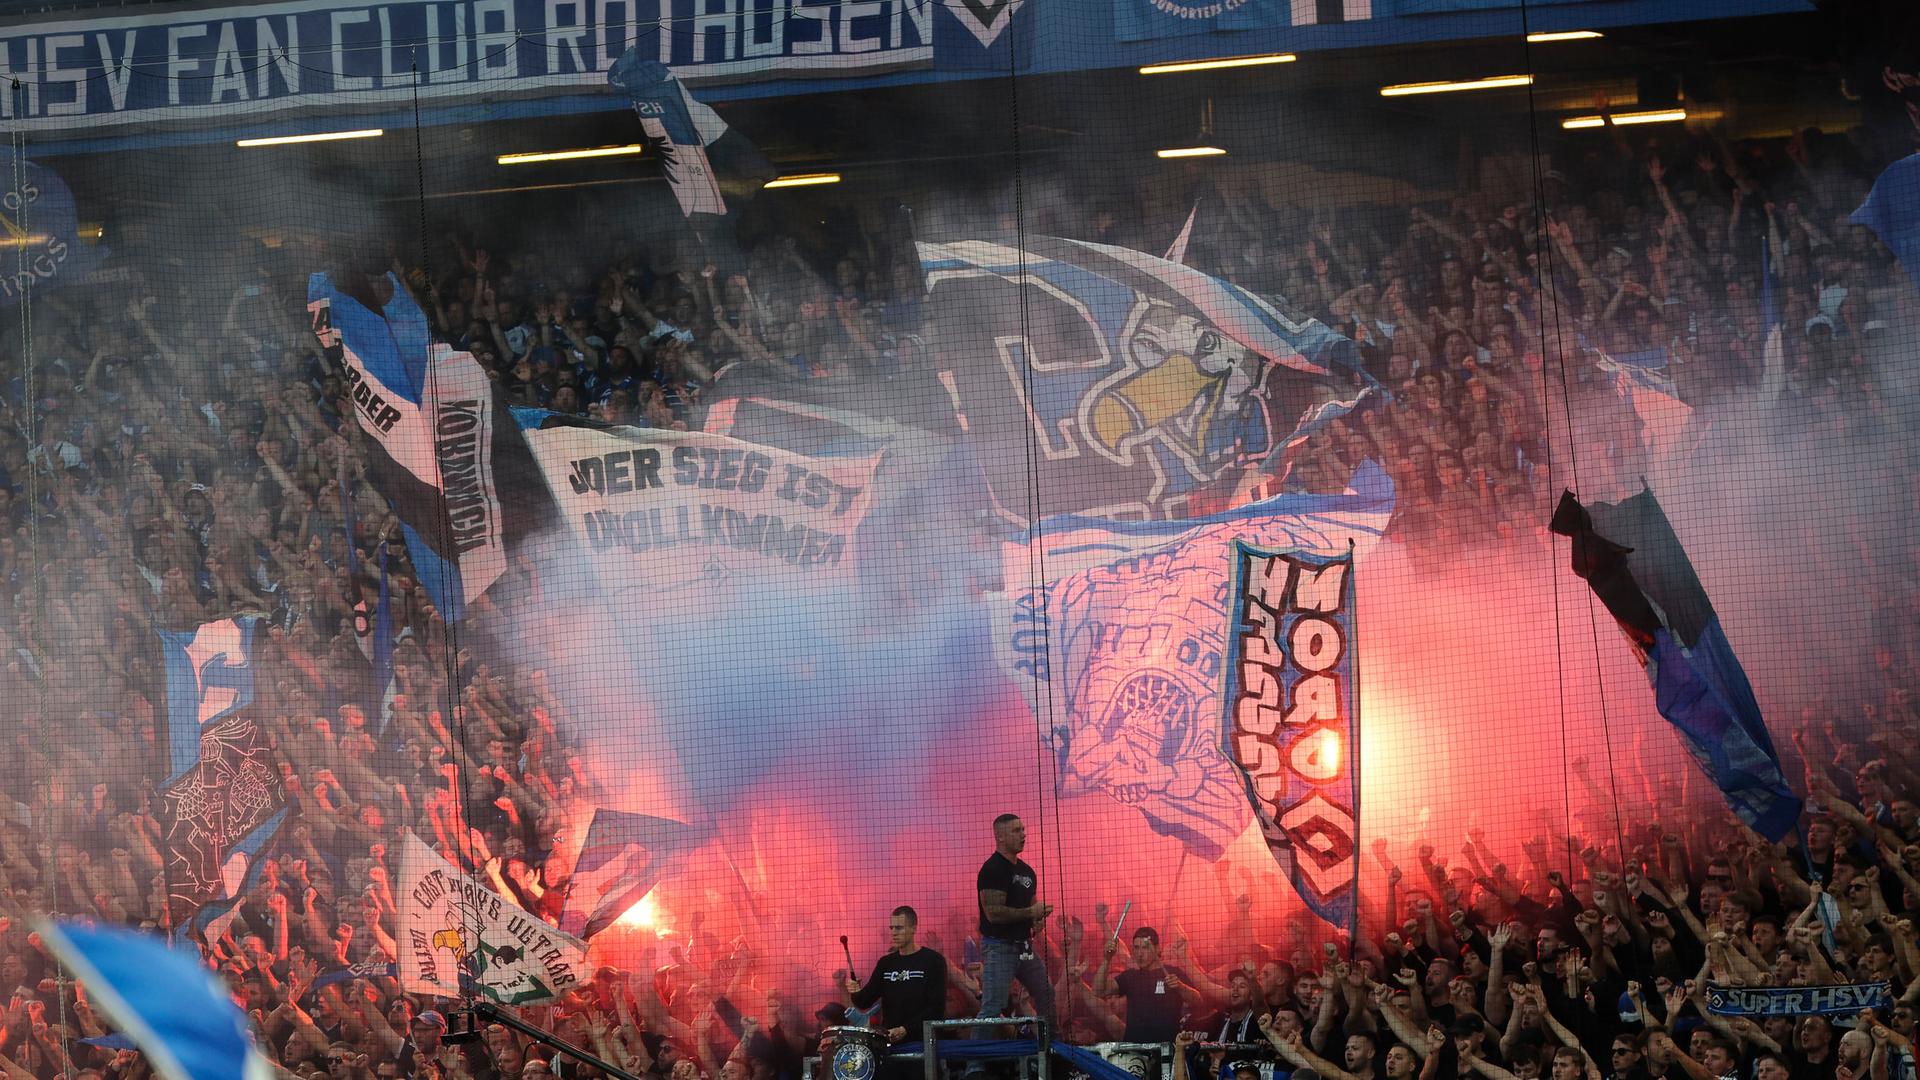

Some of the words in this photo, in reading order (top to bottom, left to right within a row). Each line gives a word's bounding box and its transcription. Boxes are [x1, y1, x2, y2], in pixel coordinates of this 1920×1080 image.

[0, 30, 137, 117] HSV
[168, 15, 299, 105] FAN
[330, 0, 519, 91] CLUB
[671, 446, 774, 494] SIEG
[777, 462, 864, 516] IST
[1726, 988, 1803, 1014] SUPER
